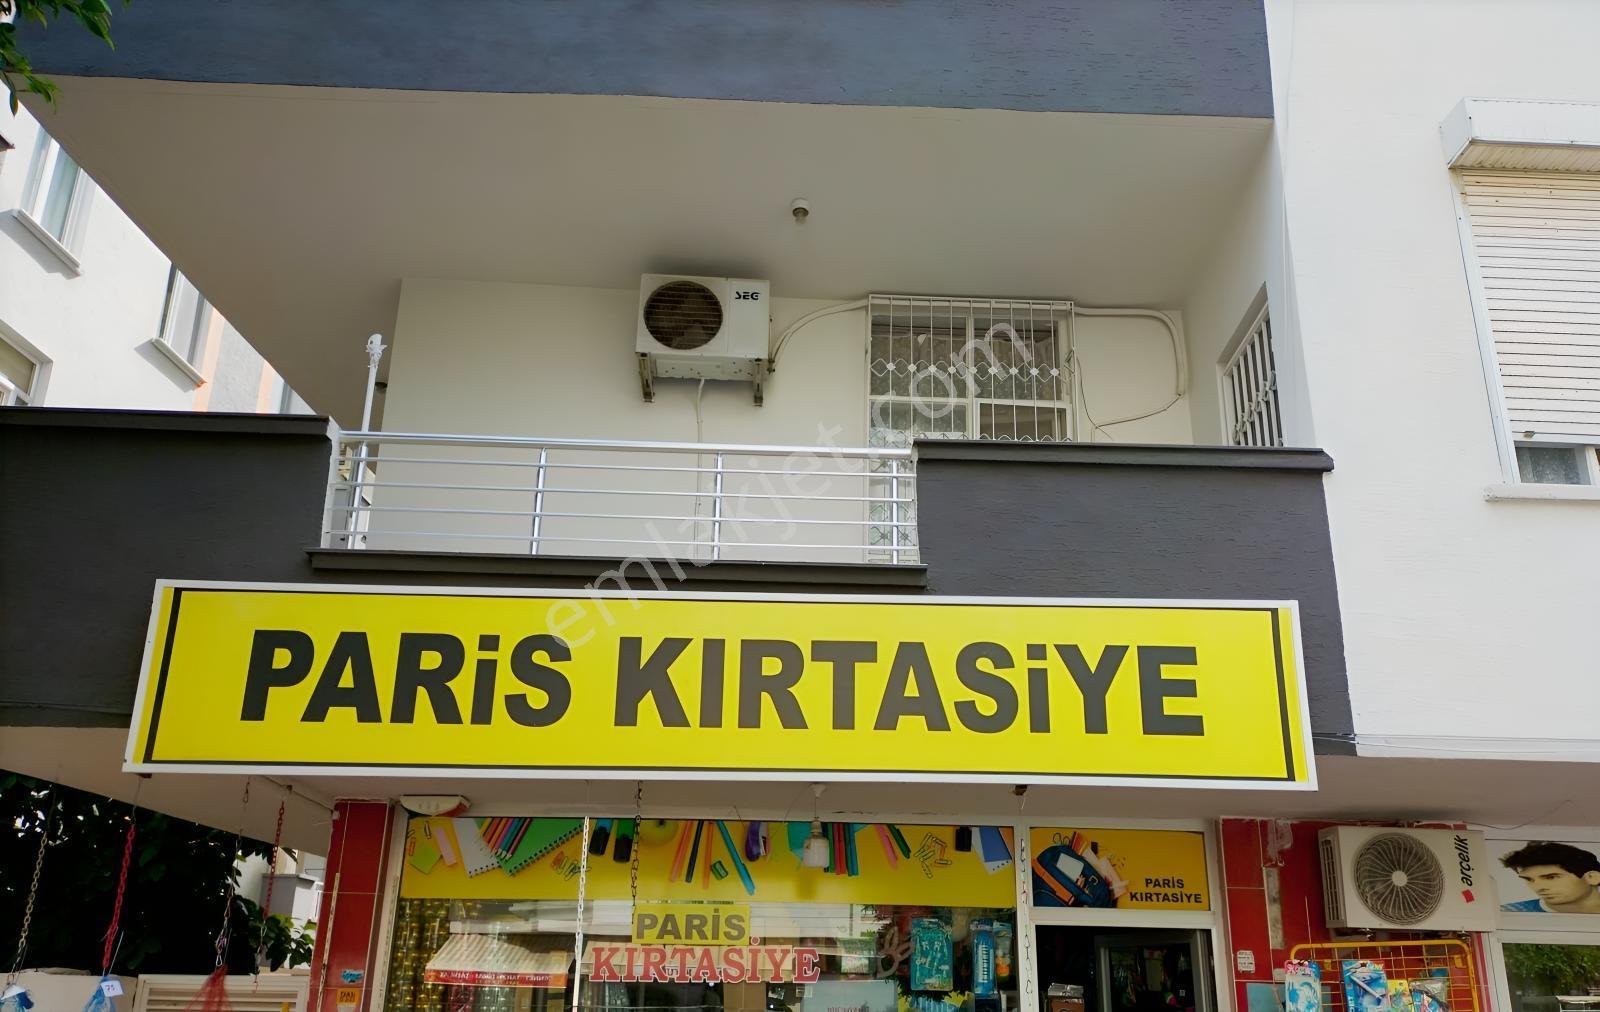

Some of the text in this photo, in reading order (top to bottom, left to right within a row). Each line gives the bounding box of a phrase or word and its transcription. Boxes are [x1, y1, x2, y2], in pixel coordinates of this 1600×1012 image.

[735, 290, 762, 301] SEG
[1453, 834, 1475, 887] arçelik
[1144, 876, 1186, 889] PARİS
[1129, 890, 1203, 904] KIRTASİYE
[635, 907, 747, 942] PARİS
[589, 935, 821, 984] KIRTASİYE
